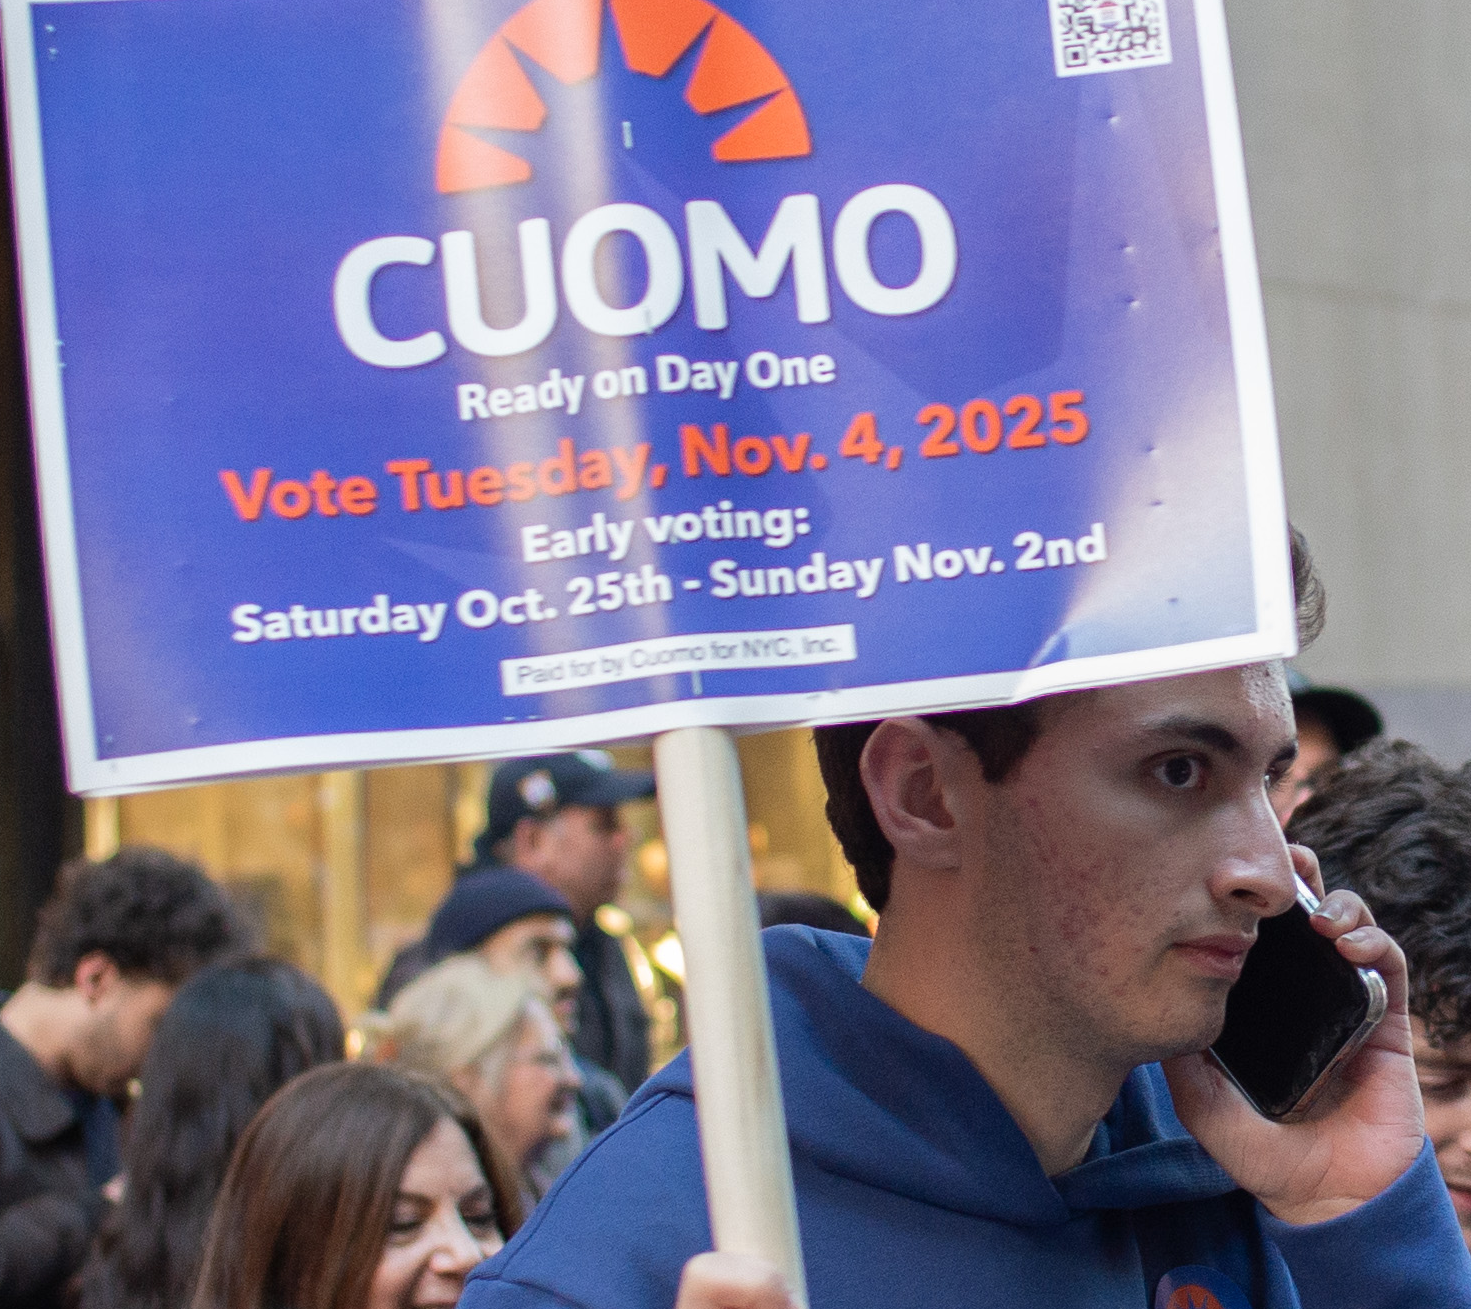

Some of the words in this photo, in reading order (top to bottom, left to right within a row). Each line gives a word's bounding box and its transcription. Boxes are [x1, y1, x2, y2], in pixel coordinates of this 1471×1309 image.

[334, 184, 956, 367] CUOMO
[459, 369, 584, 420] Ready
[592, 367, 646, 399] on
[656, 355, 738, 399] Day
[748, 351, 835, 388] One
[221, 468, 378, 521] Vote
[387, 437, 667, 511] Tuesday,
[681, 424, 827, 477] Nov.
[841, 412, 902, 470] 4,
[918, 391, 1089, 457] 2025
[231, 594, 447, 642] Saturday
[457, 570, 564, 630] Oct.
[565, 564, 672, 615] 25th
[710, 552, 884, 598] Sunday
[893, 543, 1005, 582] Nov.
[1014, 519, 1107, 572] 2nd
[521, 513, 635, 562] Early
[642, 503, 810, 557] voting:
[515, 660, 566, 687] Paid
[569, 657, 597, 680] for
[600, 651, 625, 679] by
[628, 641, 706, 672] Cuomo
[710, 639, 740, 663] for
[740, 635, 801, 665] NYC,
[802, 631, 843, 658] Inc.
